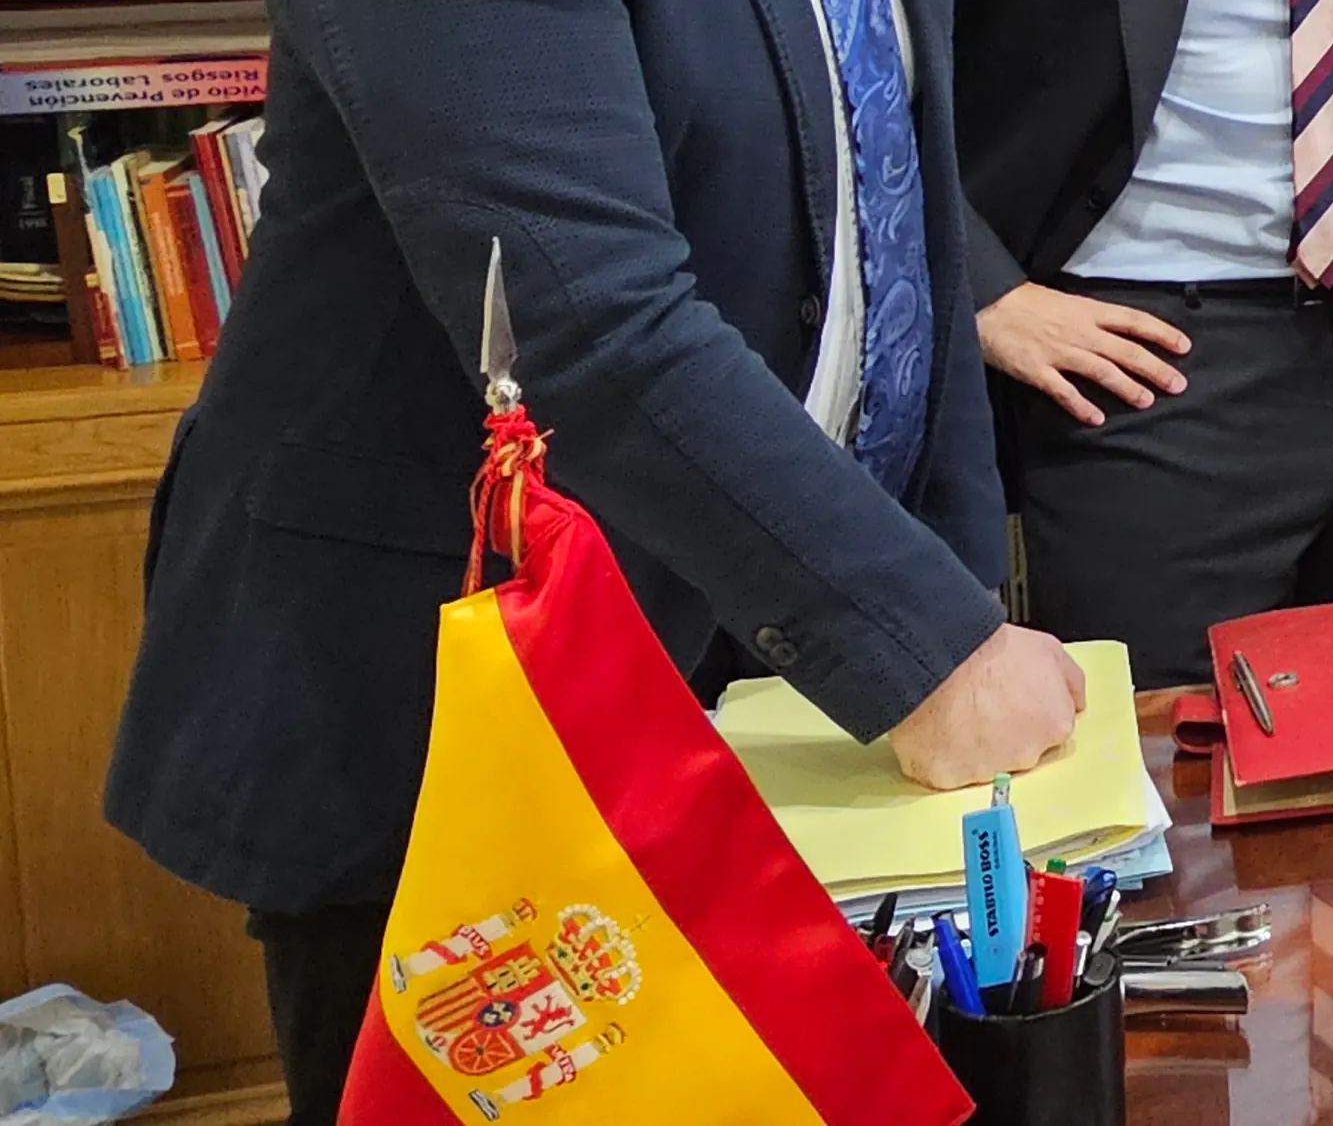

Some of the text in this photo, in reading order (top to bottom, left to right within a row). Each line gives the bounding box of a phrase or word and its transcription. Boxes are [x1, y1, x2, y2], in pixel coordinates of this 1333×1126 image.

[24, 69, 259, 93] Riesgos Laborales
[28, 89, 164, 108] Prevención
[171, 87, 200, 101] de
[978, 831, 1000, 937] STABILO BOSS
